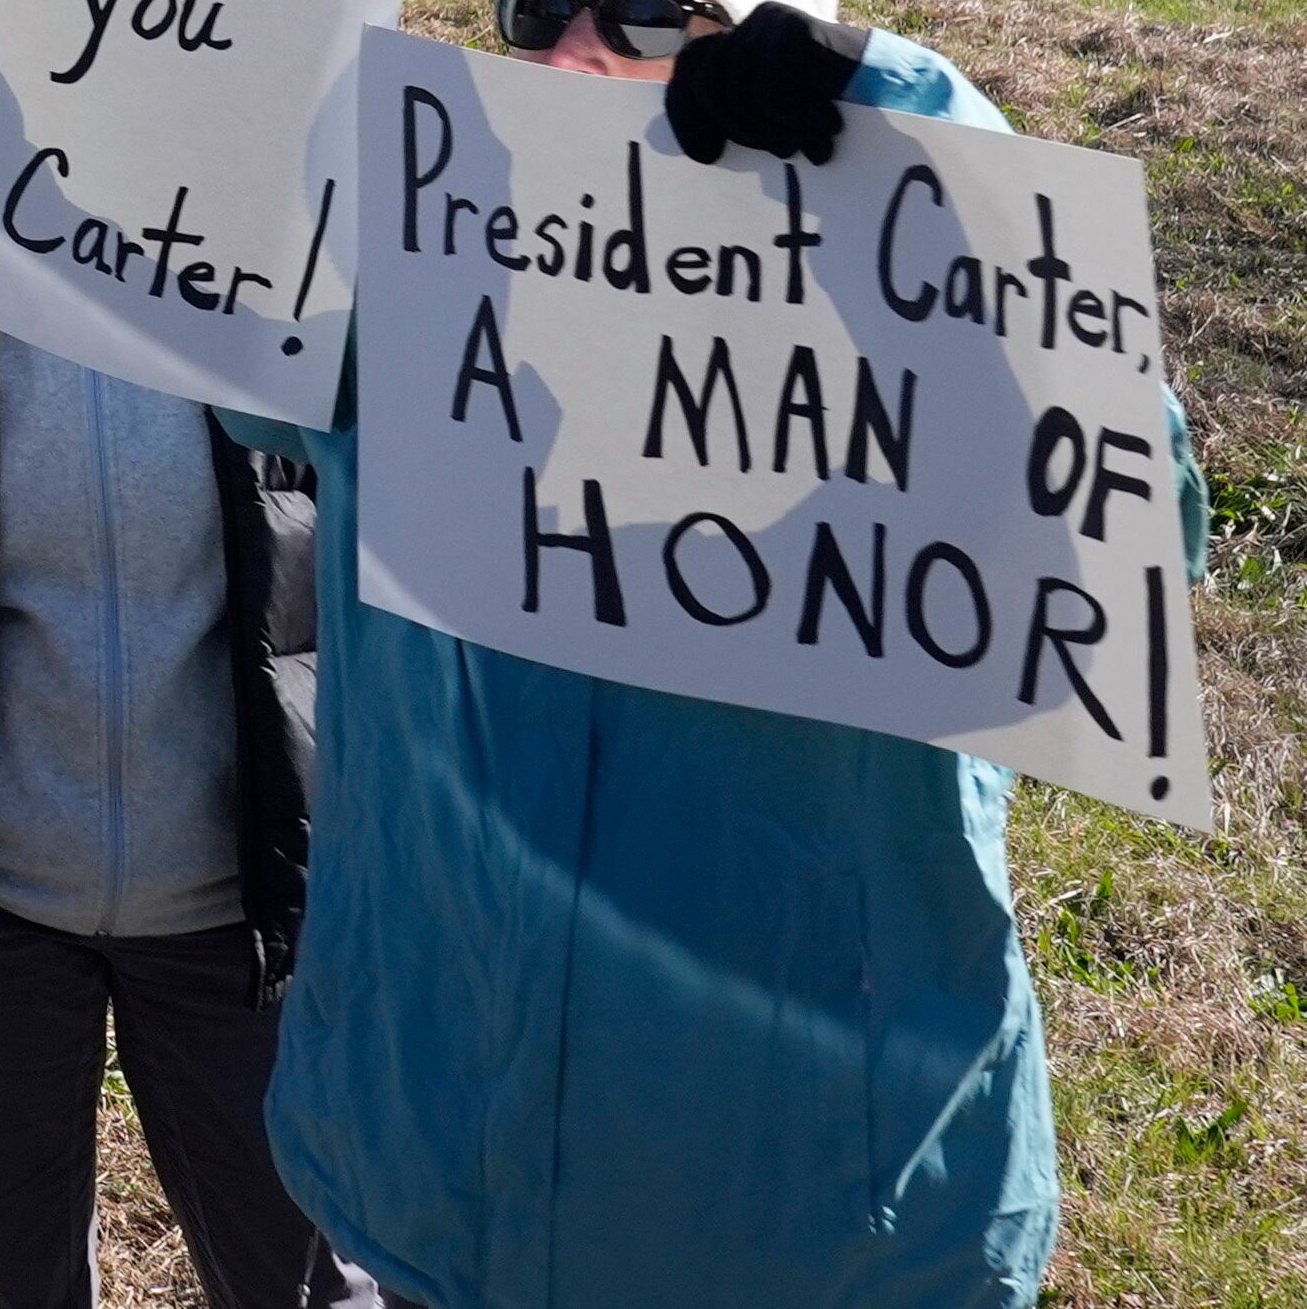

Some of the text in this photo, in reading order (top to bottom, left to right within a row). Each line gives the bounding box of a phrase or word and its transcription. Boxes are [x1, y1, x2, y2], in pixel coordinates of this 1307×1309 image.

[2, 147, 336, 357] Carter!
[402, 85, 1154, 375] President Carter,
[450, 294, 1151, 542] A MAN OF
[520, 466, 1170, 801] HONOR!
